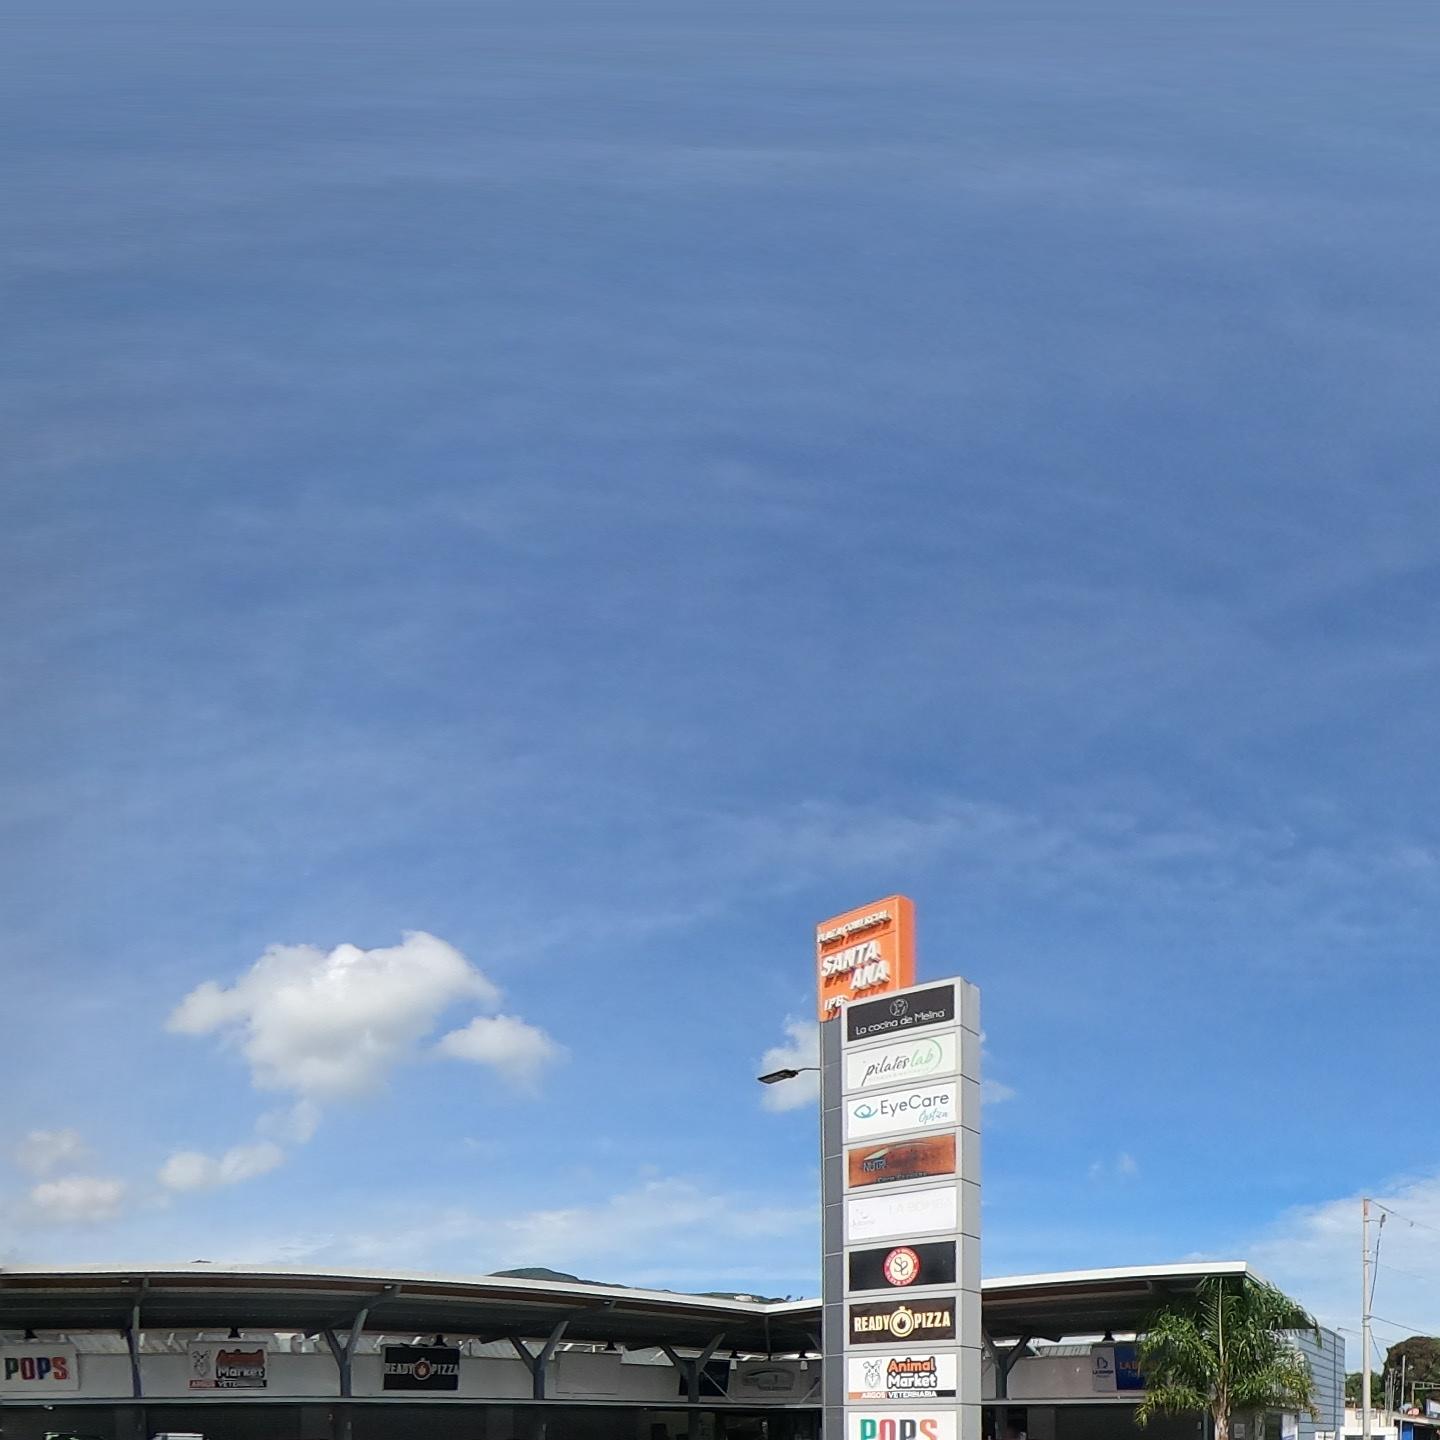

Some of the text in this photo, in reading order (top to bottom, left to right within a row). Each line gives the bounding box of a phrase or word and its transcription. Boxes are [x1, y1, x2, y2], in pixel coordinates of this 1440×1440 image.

[822, 940, 881, 977] SANTA
[850, 960, 890, 990] ANA
[855, 1010, 945, 1035] La cocina de Melina
[880, 1094, 949, 1117] EyeCare
[854, 1311, 951, 1332] READY PIZZA
[4, 1356, 69, 1380] POPS
[887, 1356, 936, 1373] Animal
[887, 1373, 937, 1389] Market
